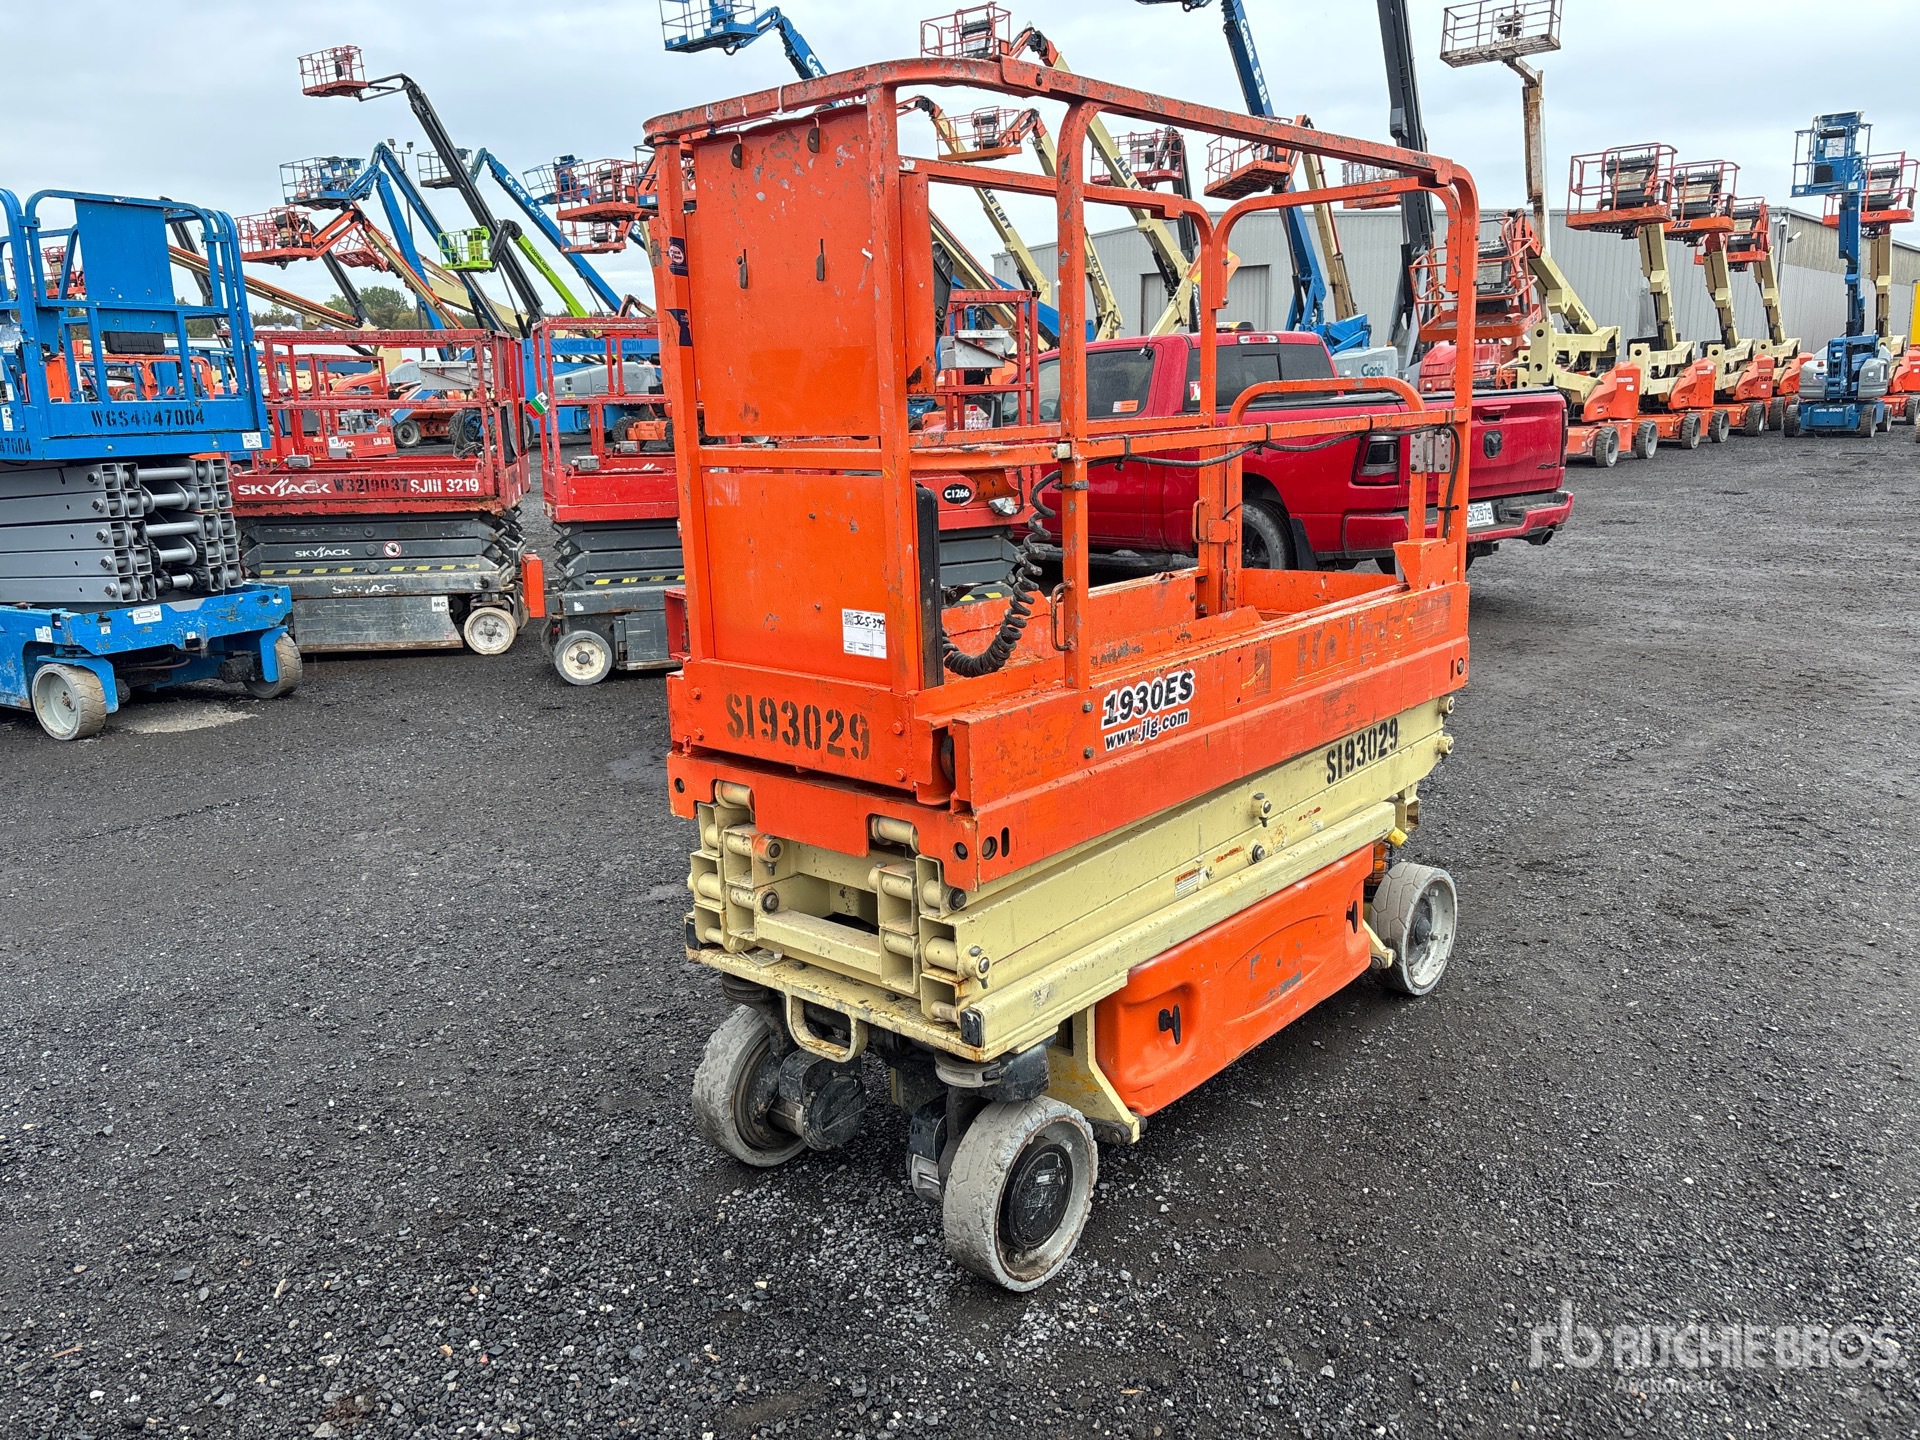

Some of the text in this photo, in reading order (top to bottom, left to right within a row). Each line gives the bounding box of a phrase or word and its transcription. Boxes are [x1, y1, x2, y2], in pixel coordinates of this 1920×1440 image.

[1240, 18, 1254, 63] Genie
[1114, 156, 1133, 181] JLG
[994, 206, 1012, 229] LIFT
[1670, 220, 1692, 230] JLG
[528, 245, 550, 272] ZOOMLION
[1361, 363, 1384, 377] Genie
[91, 408, 205, 428] WGS4047004
[237, 478, 332, 498] SKYJACK
[445, 478, 480, 493] 3219
[294, 546, 352, 558] SKYJACK
[1102, 670, 1195, 728] 1930ES
[1104, 709, 1189, 751] www.jlg.com
